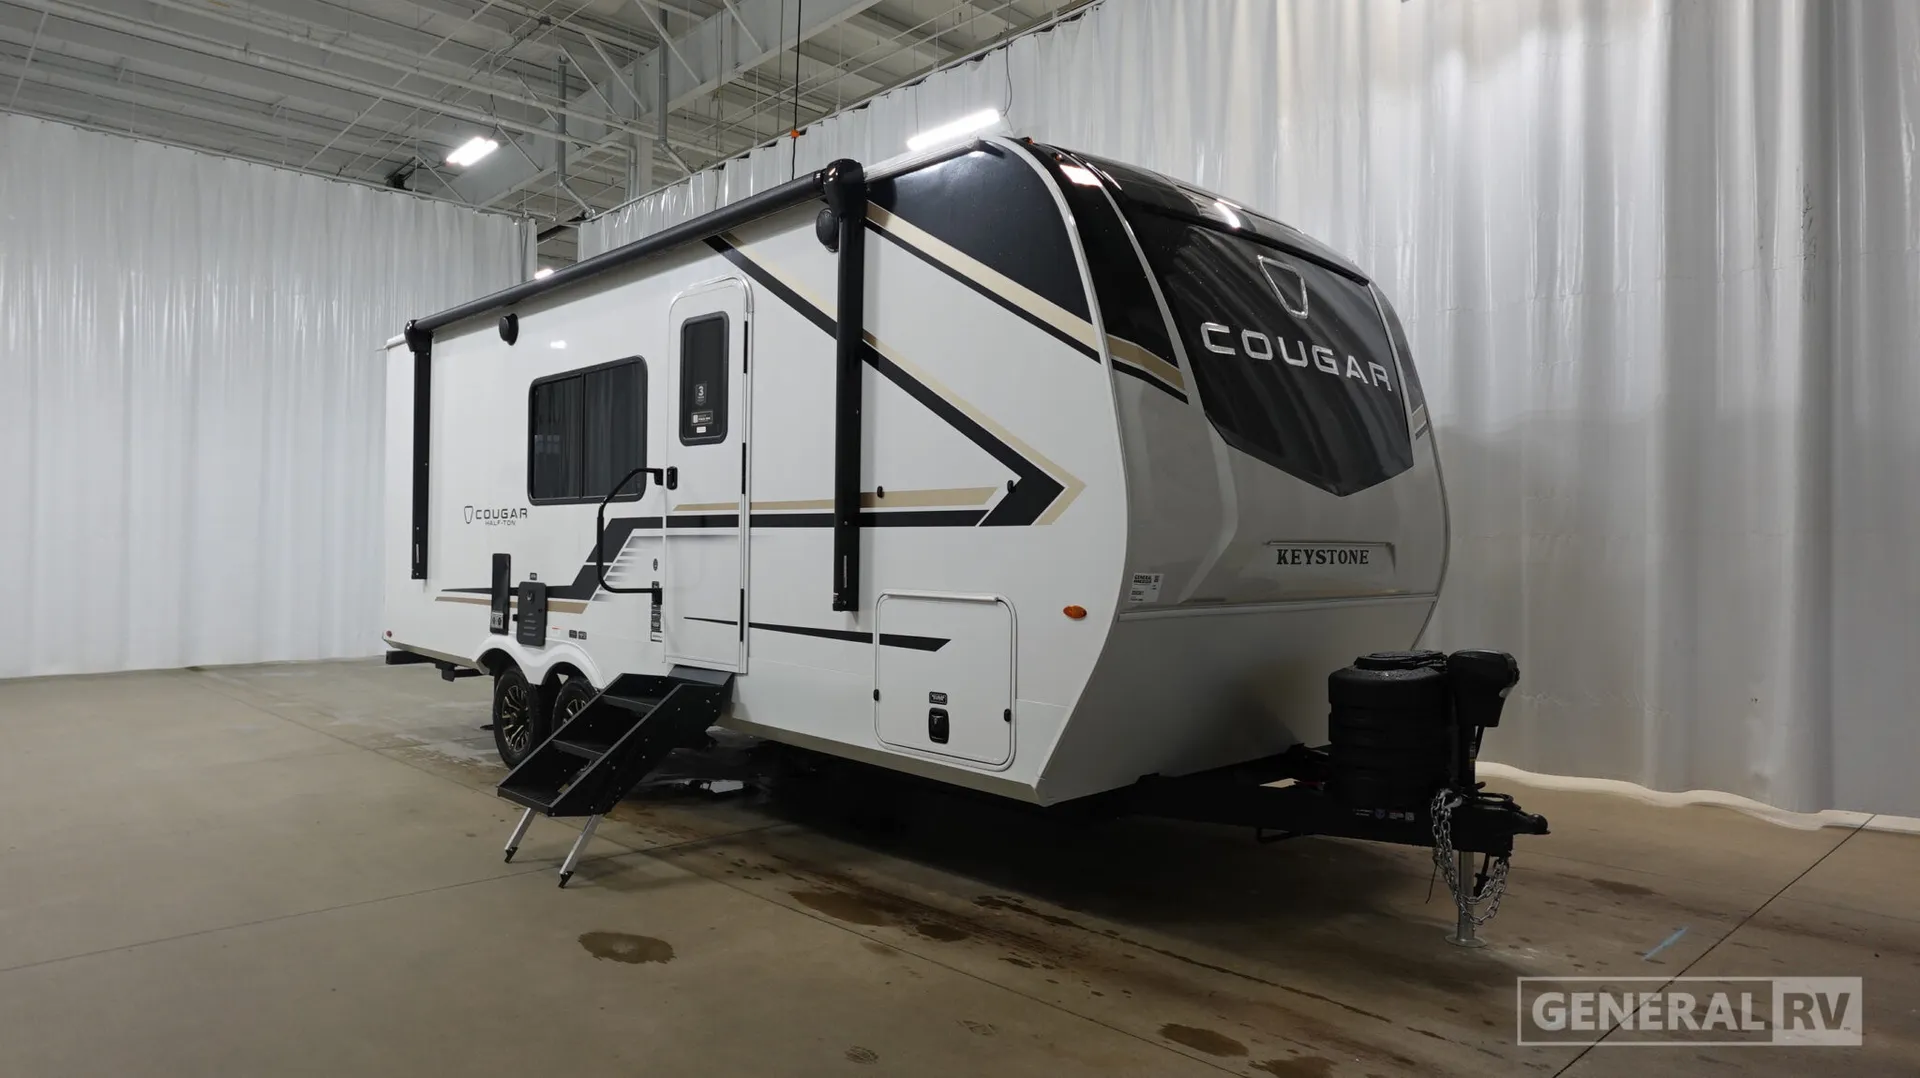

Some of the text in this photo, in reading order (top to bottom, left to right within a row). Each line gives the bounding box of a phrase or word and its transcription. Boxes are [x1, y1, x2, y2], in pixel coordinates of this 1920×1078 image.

[1200, 321, 1392, 392] COUGAR
[698, 385, 704, 396] 3
[475, 507, 528, 520] COUGAR
[1276, 548, 1370, 565] KEYSTONE
